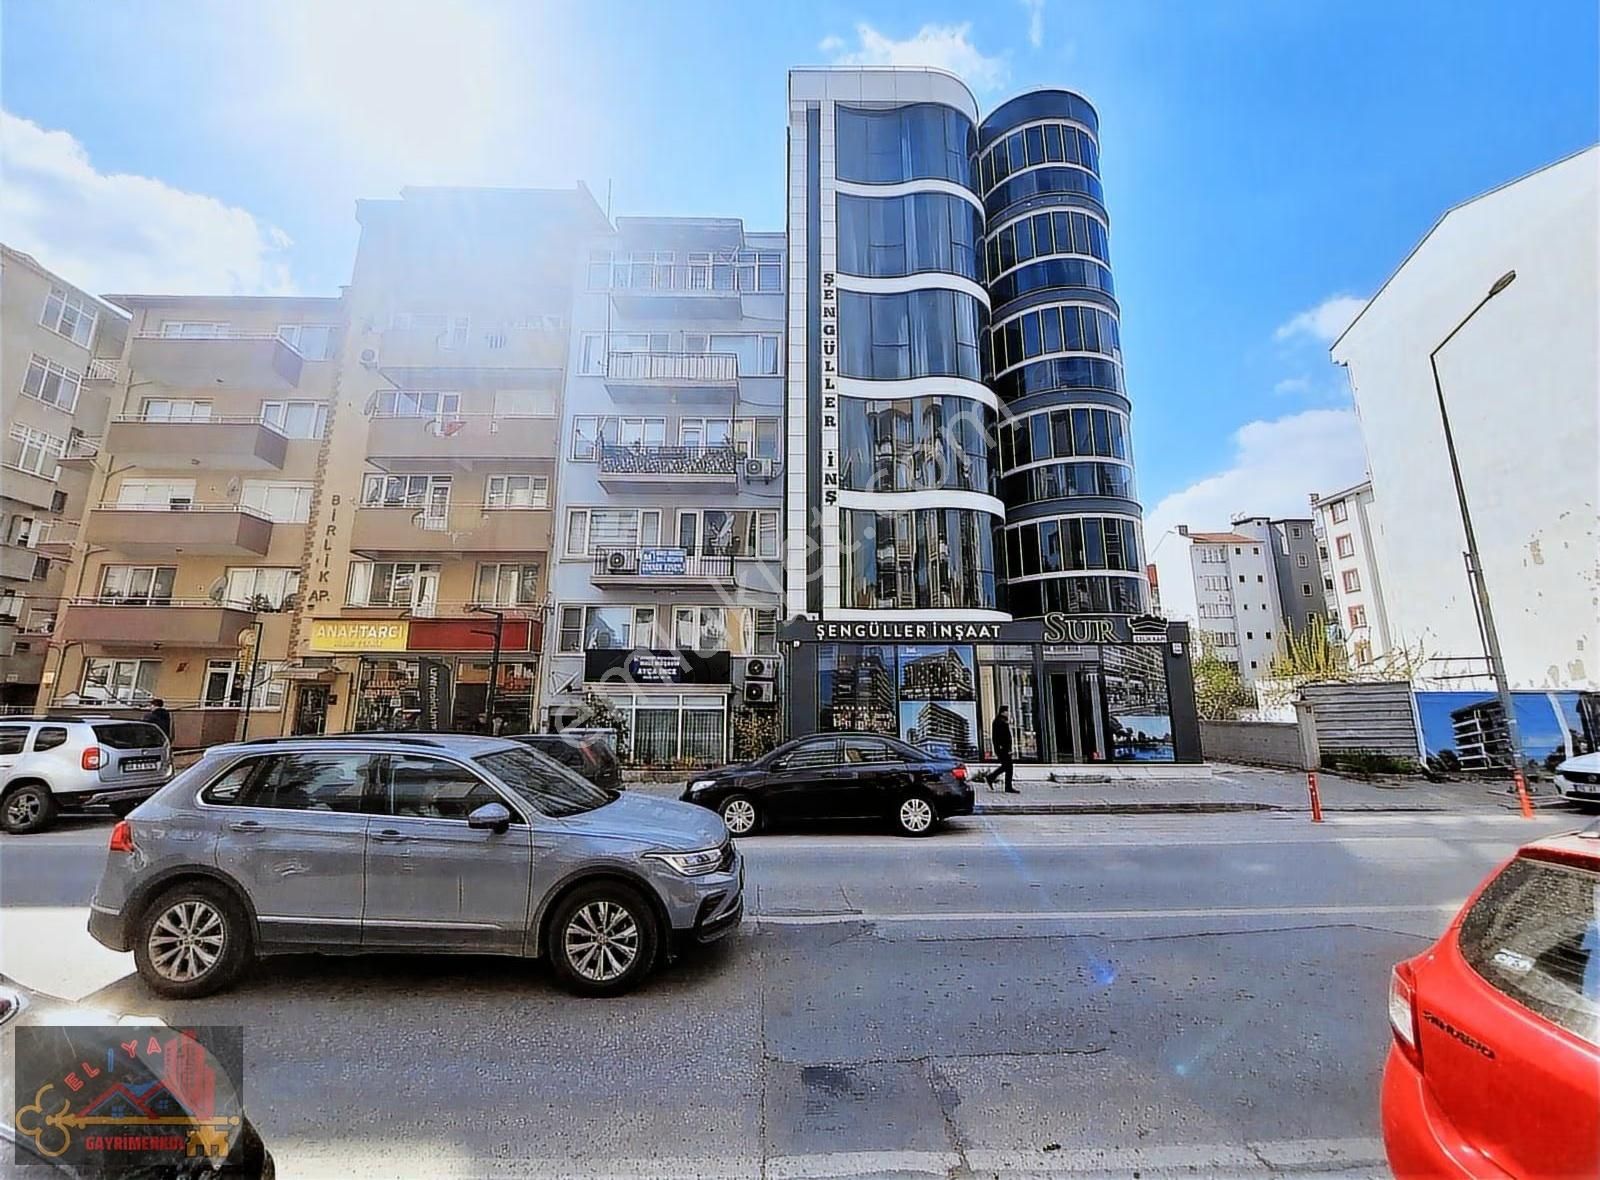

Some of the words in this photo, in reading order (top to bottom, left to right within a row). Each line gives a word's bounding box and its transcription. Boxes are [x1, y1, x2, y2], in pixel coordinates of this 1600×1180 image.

[823, 273, 837, 428] ŞENGÜLLER
[824, 451, 838, 505] İNŞ
[318, 494, 341, 583] BİRLİK
[318, 623, 403, 639] ANAHTARCI
[816, 621, 926, 640] ŞENGÜLLER
[932, 620, 1001, 640] İNŞAAT
